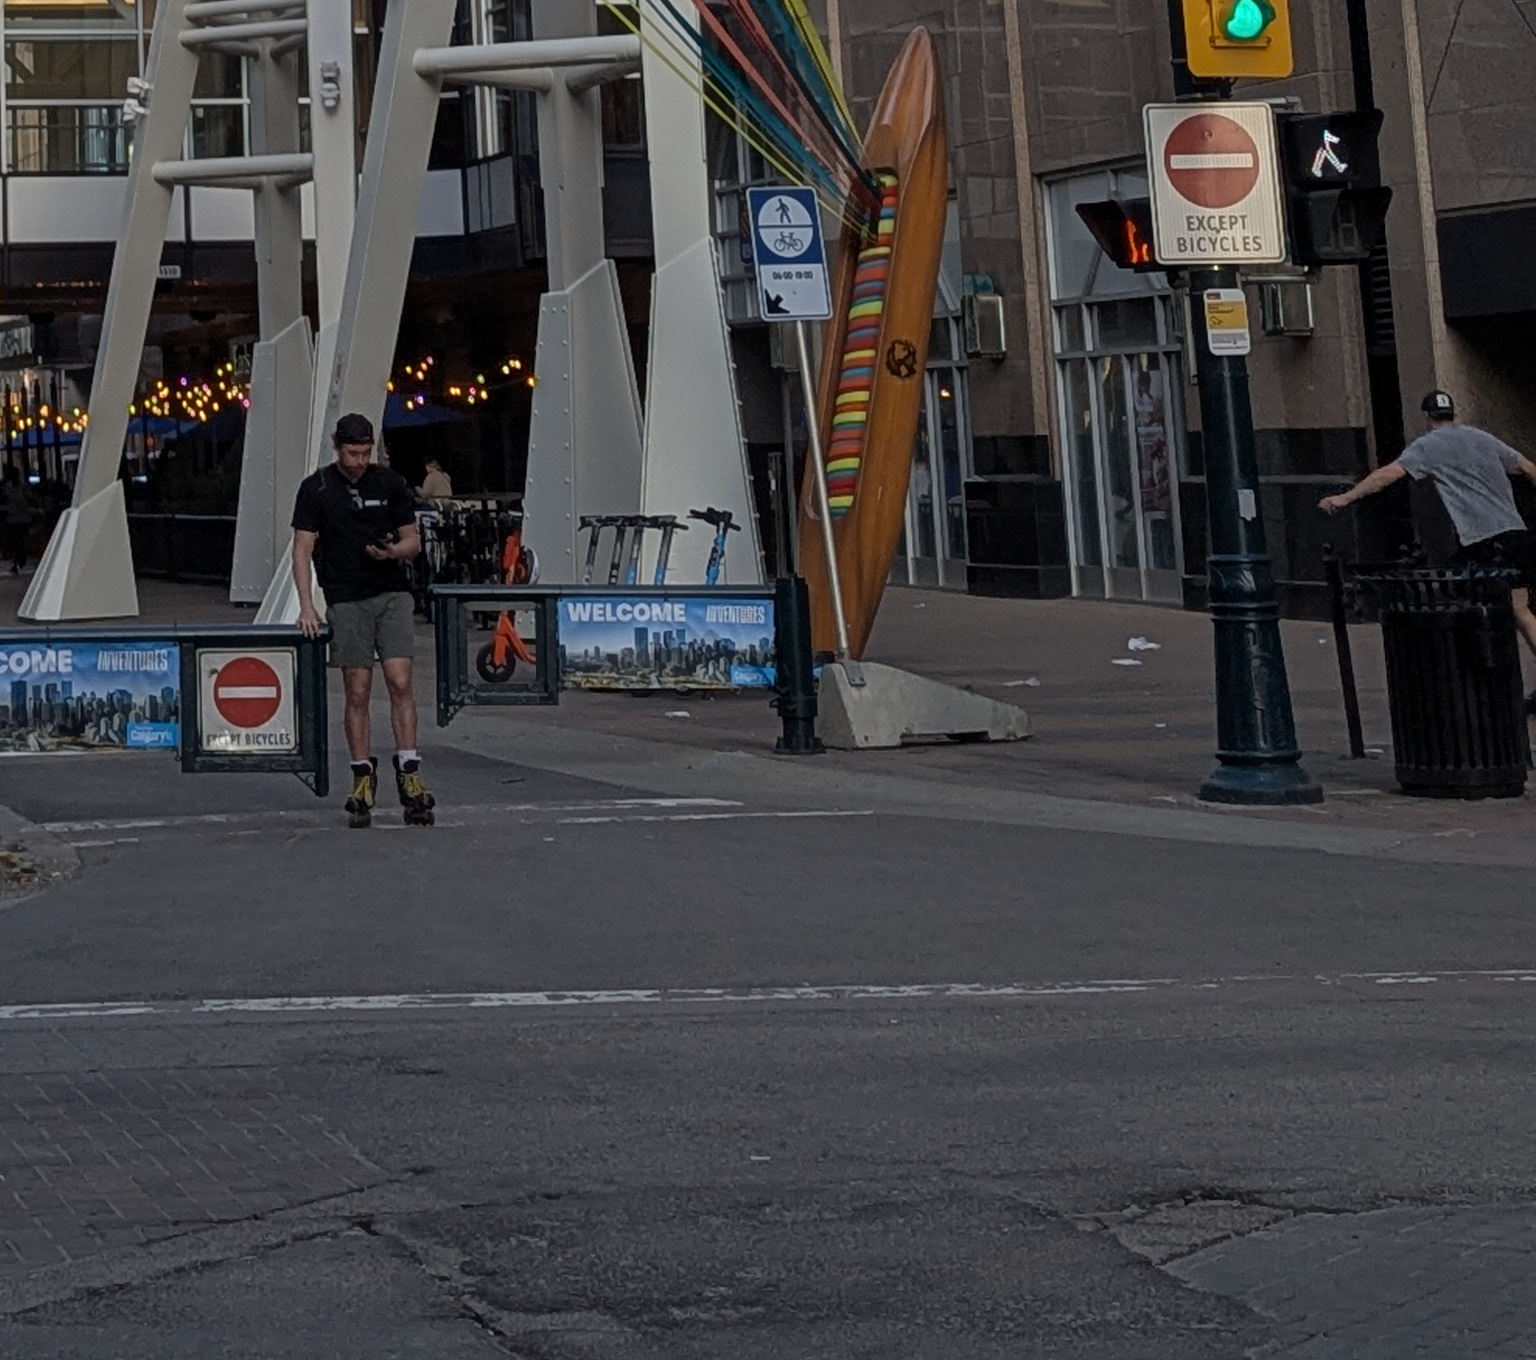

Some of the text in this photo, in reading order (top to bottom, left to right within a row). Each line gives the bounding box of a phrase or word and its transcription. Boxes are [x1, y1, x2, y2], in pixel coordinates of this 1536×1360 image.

[1185, 214, 1248, 231] EXCEPT
[1176, 235, 1263, 253] BICYCLES
[566, 602, 686, 623] WELCOME
[206, 733, 291, 747] EXPT BICYCLES
